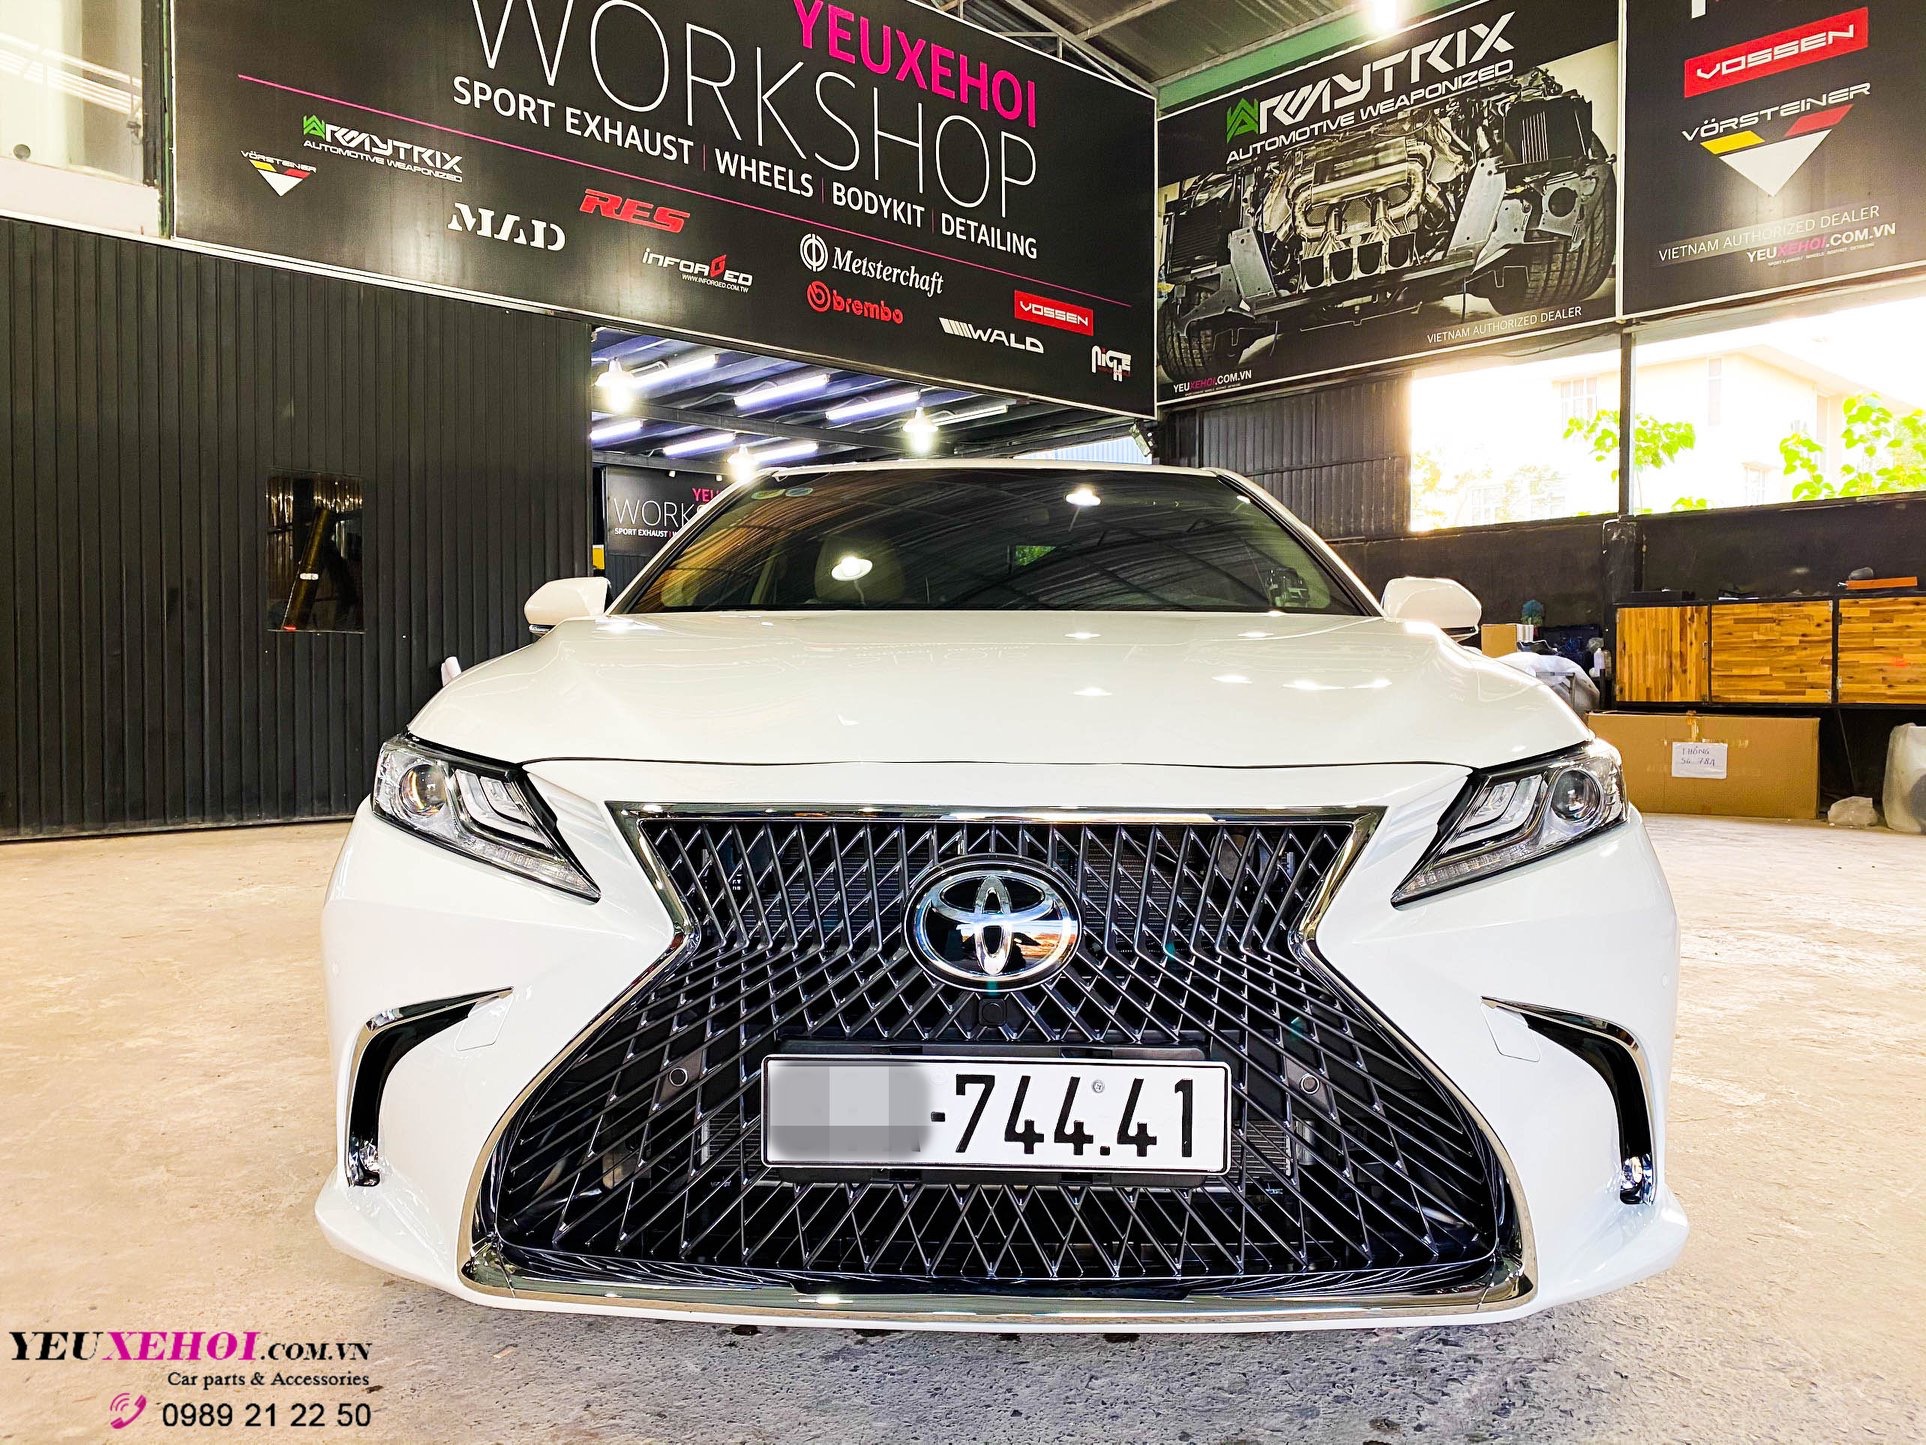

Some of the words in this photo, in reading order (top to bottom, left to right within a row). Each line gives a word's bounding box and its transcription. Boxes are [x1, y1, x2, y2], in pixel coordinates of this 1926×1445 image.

[793, 0, 1036, 128] YEUXEHOI
[1696, 24, 1855, 80] VOSSEN
[471, 0, 1037, 219] WORKSHOP
[1226, 112, 1356, 165] AUTOMOTIVE
[1360, 59, 1514, 120] WEAPONIZED
[1681, 82, 1872, 142] VÖRSTEINER
[303, 140, 385, 165] AUTOMOTIVE
[387, 159, 463, 183] WEAPONIZED
[453, 76, 556, 127] SPORT
[566, 106, 694, 165] EXHAUST
[715, 148, 814, 198] WHEELS
[833, 181, 925, 228] BODYKIT
[941, 212, 1038, 260] DETAILING
[447, 202, 566, 251] MAD
[579, 188, 691, 234] RES
[1658, 238, 1719, 262] VIETNAM
[1723, 219, 1816, 250] AUTHORIZED
[1820, 205, 1880, 229] DEALER
[1746, 222, 1896, 263] YEUXEHOI.COM.VN
[832, 246, 945, 297] Meisterchaft
[833, 290, 904, 324] brembo
[1020, 300, 1089, 327] VOSSEN
[1427, 325, 1470, 344] VIETNAM
[1472, 314, 1538, 336] AUTHORIZED
[1540, 305, 1582, 322] DEALER
[968, 323, 1045, 354] WALD
[1173, 369, 1252, 393] YEUXEHOI.COM.VN
[614, 527, 637, 535] SPORT
[638, 528, 668, 538] EXHAUST
